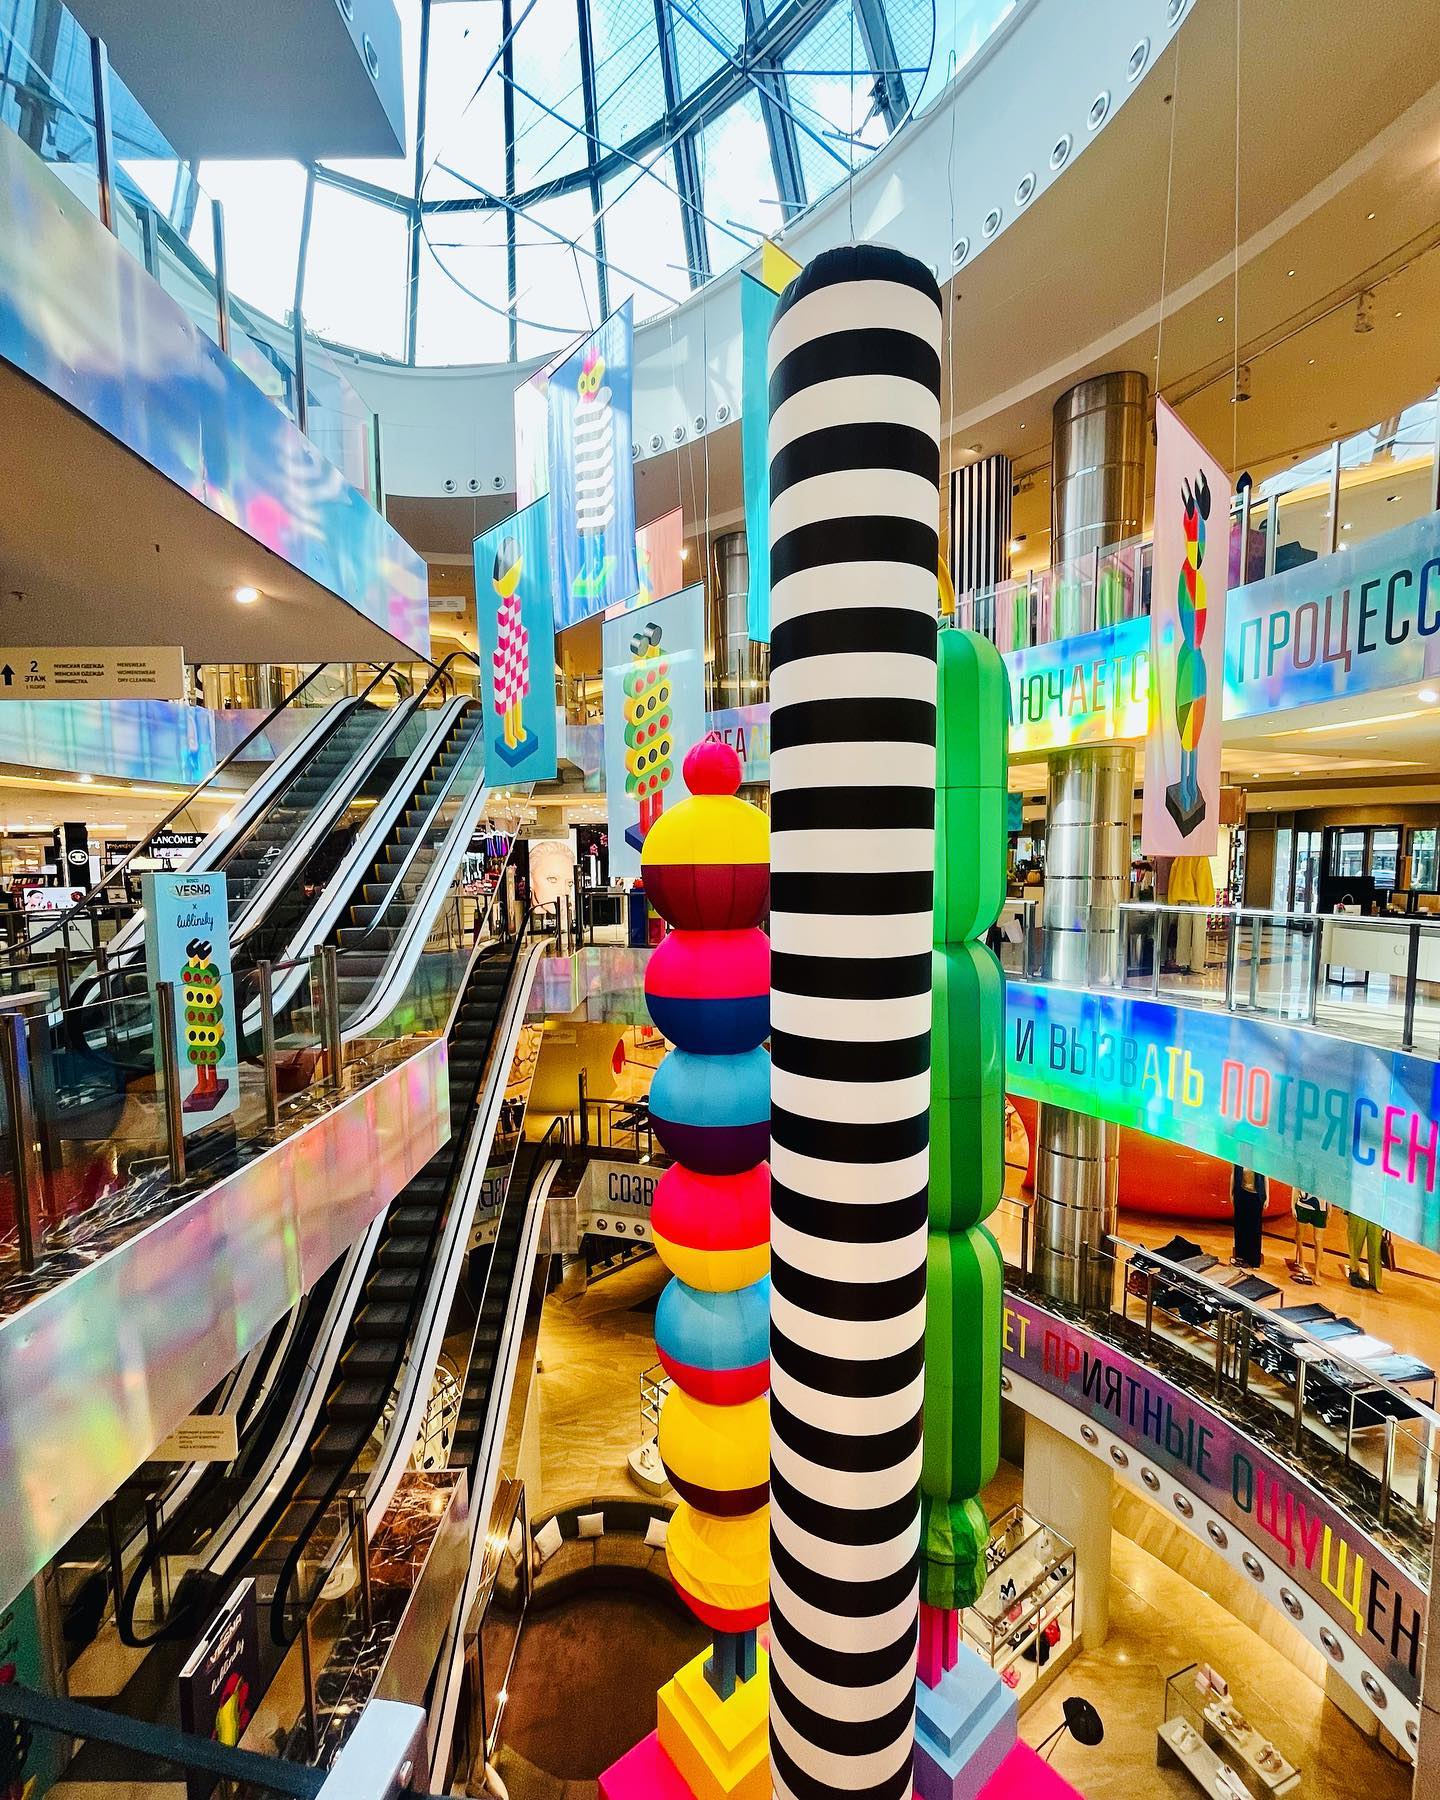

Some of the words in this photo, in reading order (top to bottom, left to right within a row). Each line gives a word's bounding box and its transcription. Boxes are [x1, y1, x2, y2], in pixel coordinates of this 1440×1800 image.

[1238, 557, 1440, 683] ПРОЦЕСС
[30, 660, 39, 673] 2
[24, 675, 46, 683] ЭТАЖ
[151, 836, 194, 844] LANCÔME
[174, 883, 211, 897] VESNA
[1015, 1017, 1035, 1066] И
[1049, 1022, 1205, 1107] ВЫЗВАТЬ
[1219, 1058, 1440, 1194] ПОТРЯСЕН
[608, 1172, 659, 1207] СОЗВ
[1043, 1328, 1215, 1486] ПРИЯТНЫЕ
[1232, 1453, 1421, 1678] ОЩУЩЕН
